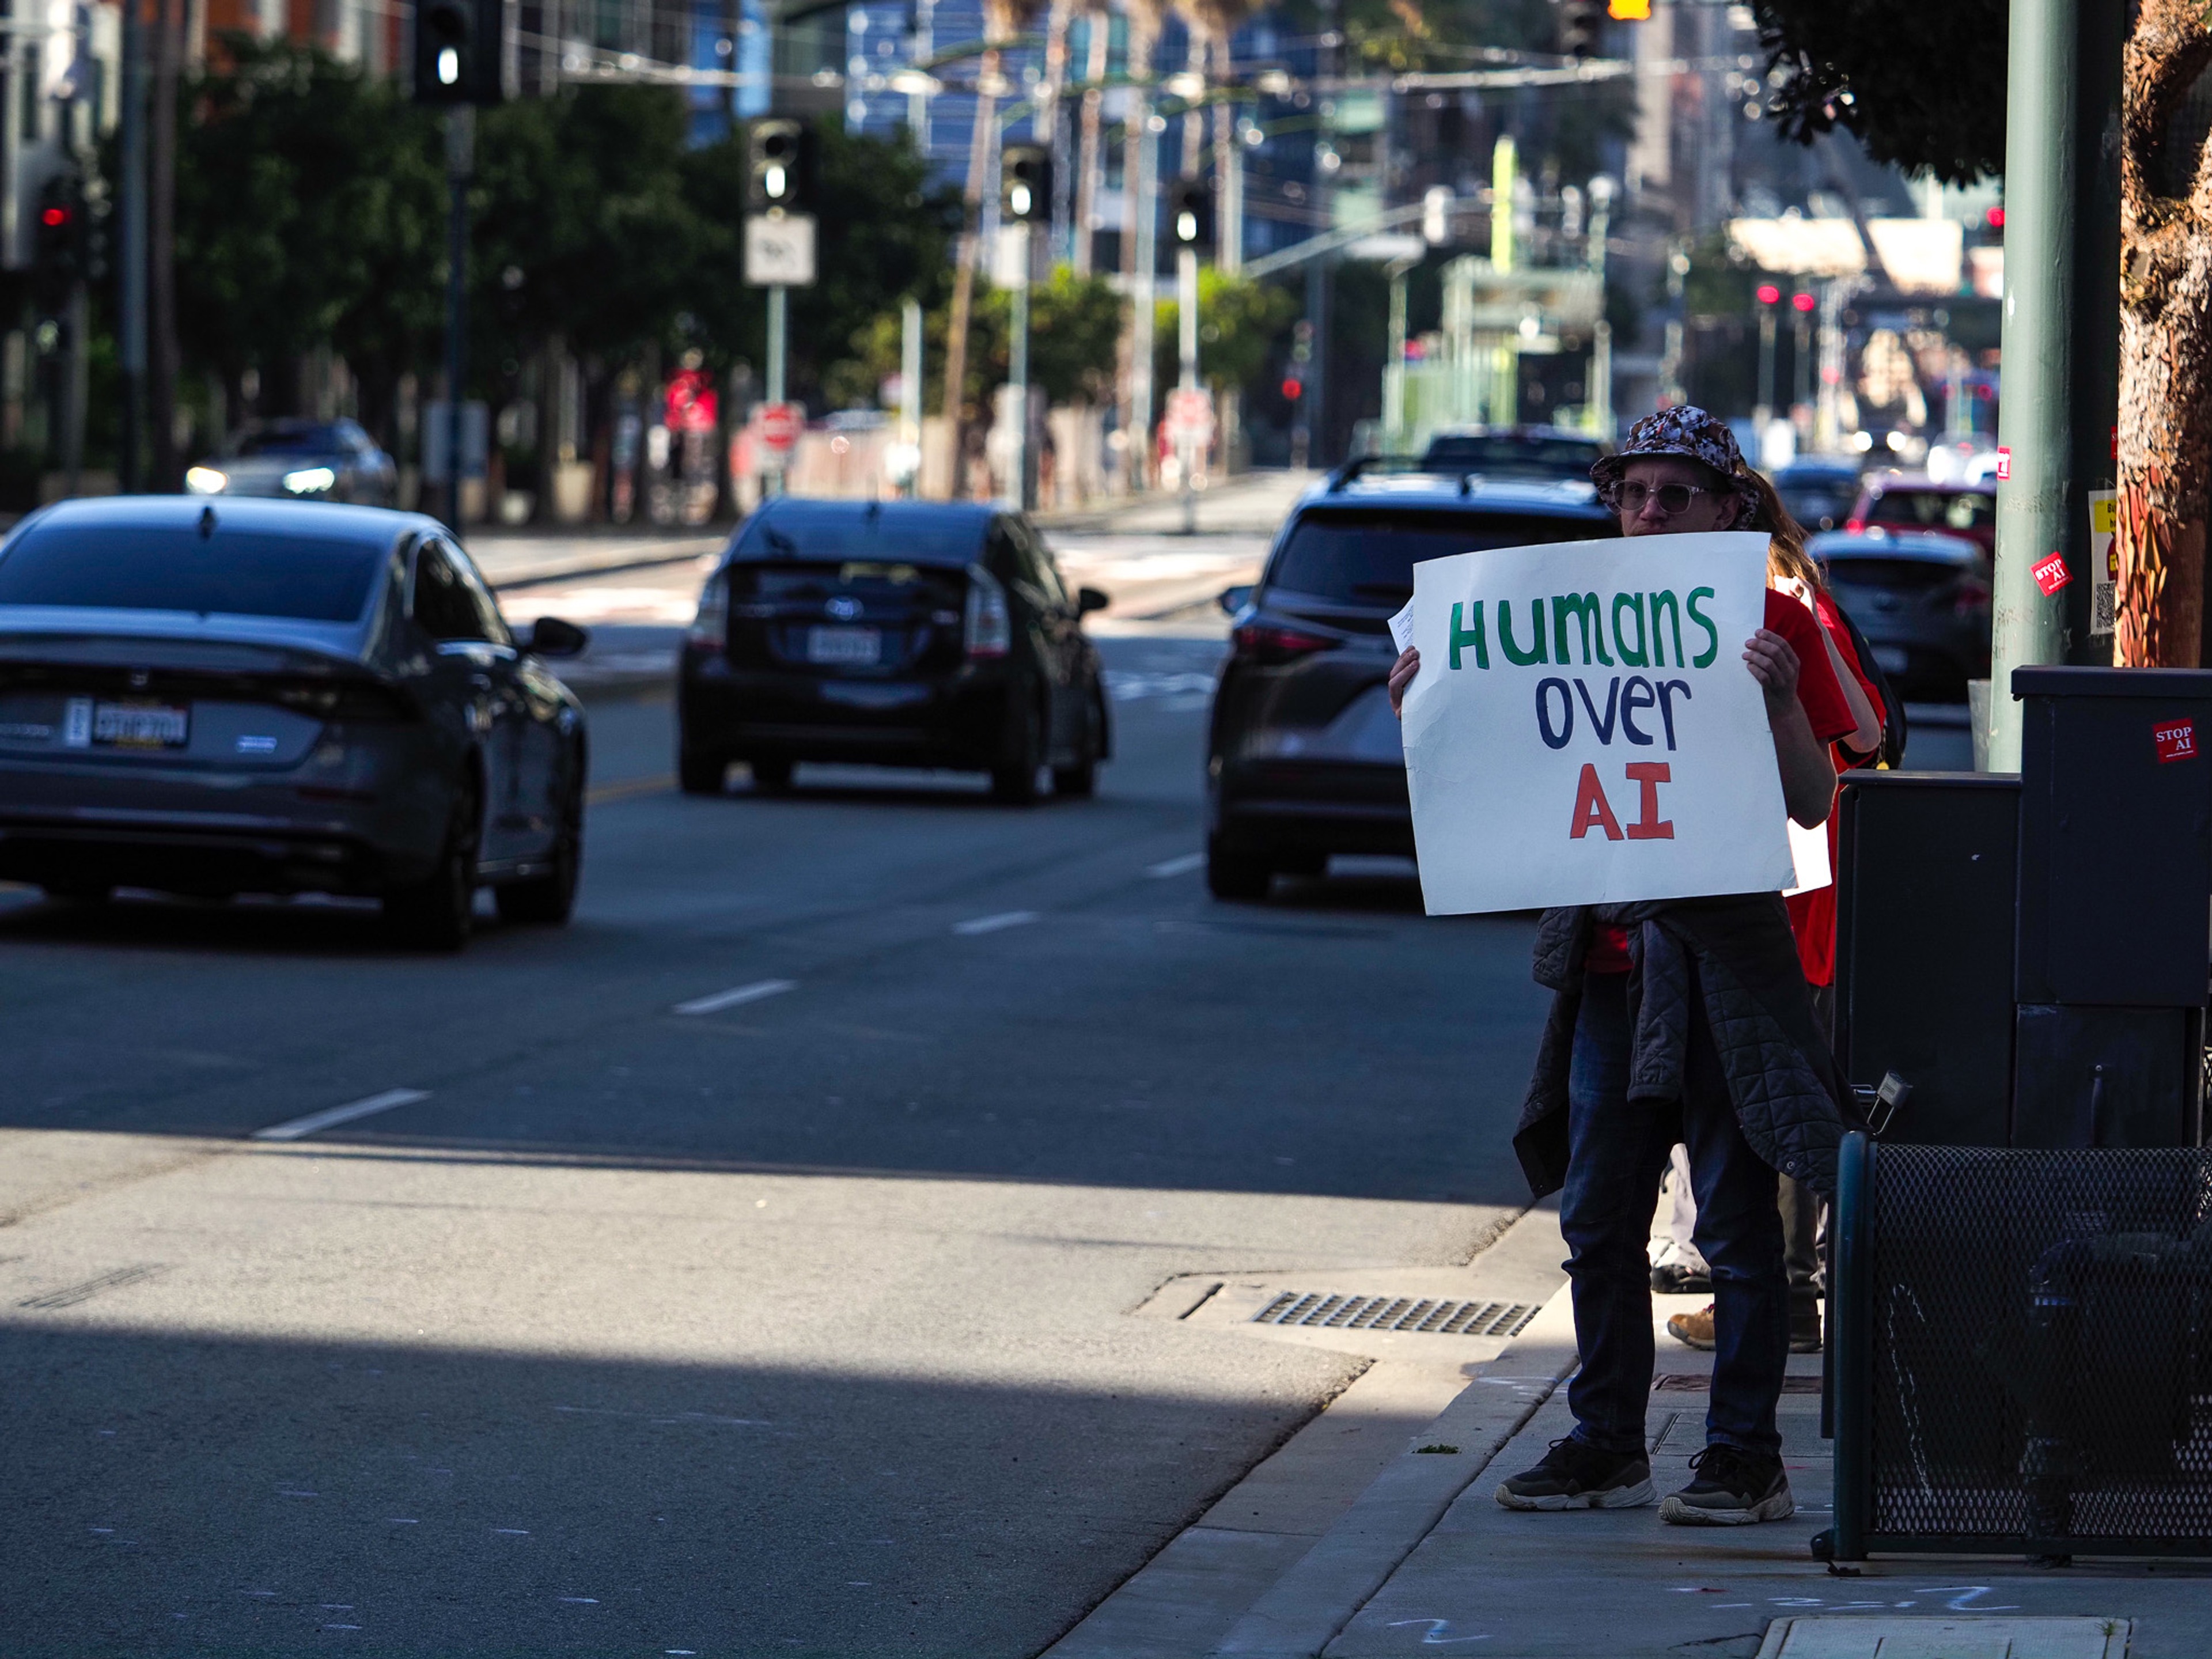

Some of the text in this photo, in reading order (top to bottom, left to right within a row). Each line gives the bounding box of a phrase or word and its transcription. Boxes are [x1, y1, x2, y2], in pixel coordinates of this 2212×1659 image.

[1449, 586, 1718, 670] Humans
[1536, 676, 1692, 751] over
[2156, 726, 2192, 742] STOP
[2176, 737, 2191, 750] AI
[1570, 762, 1675, 841] AI
